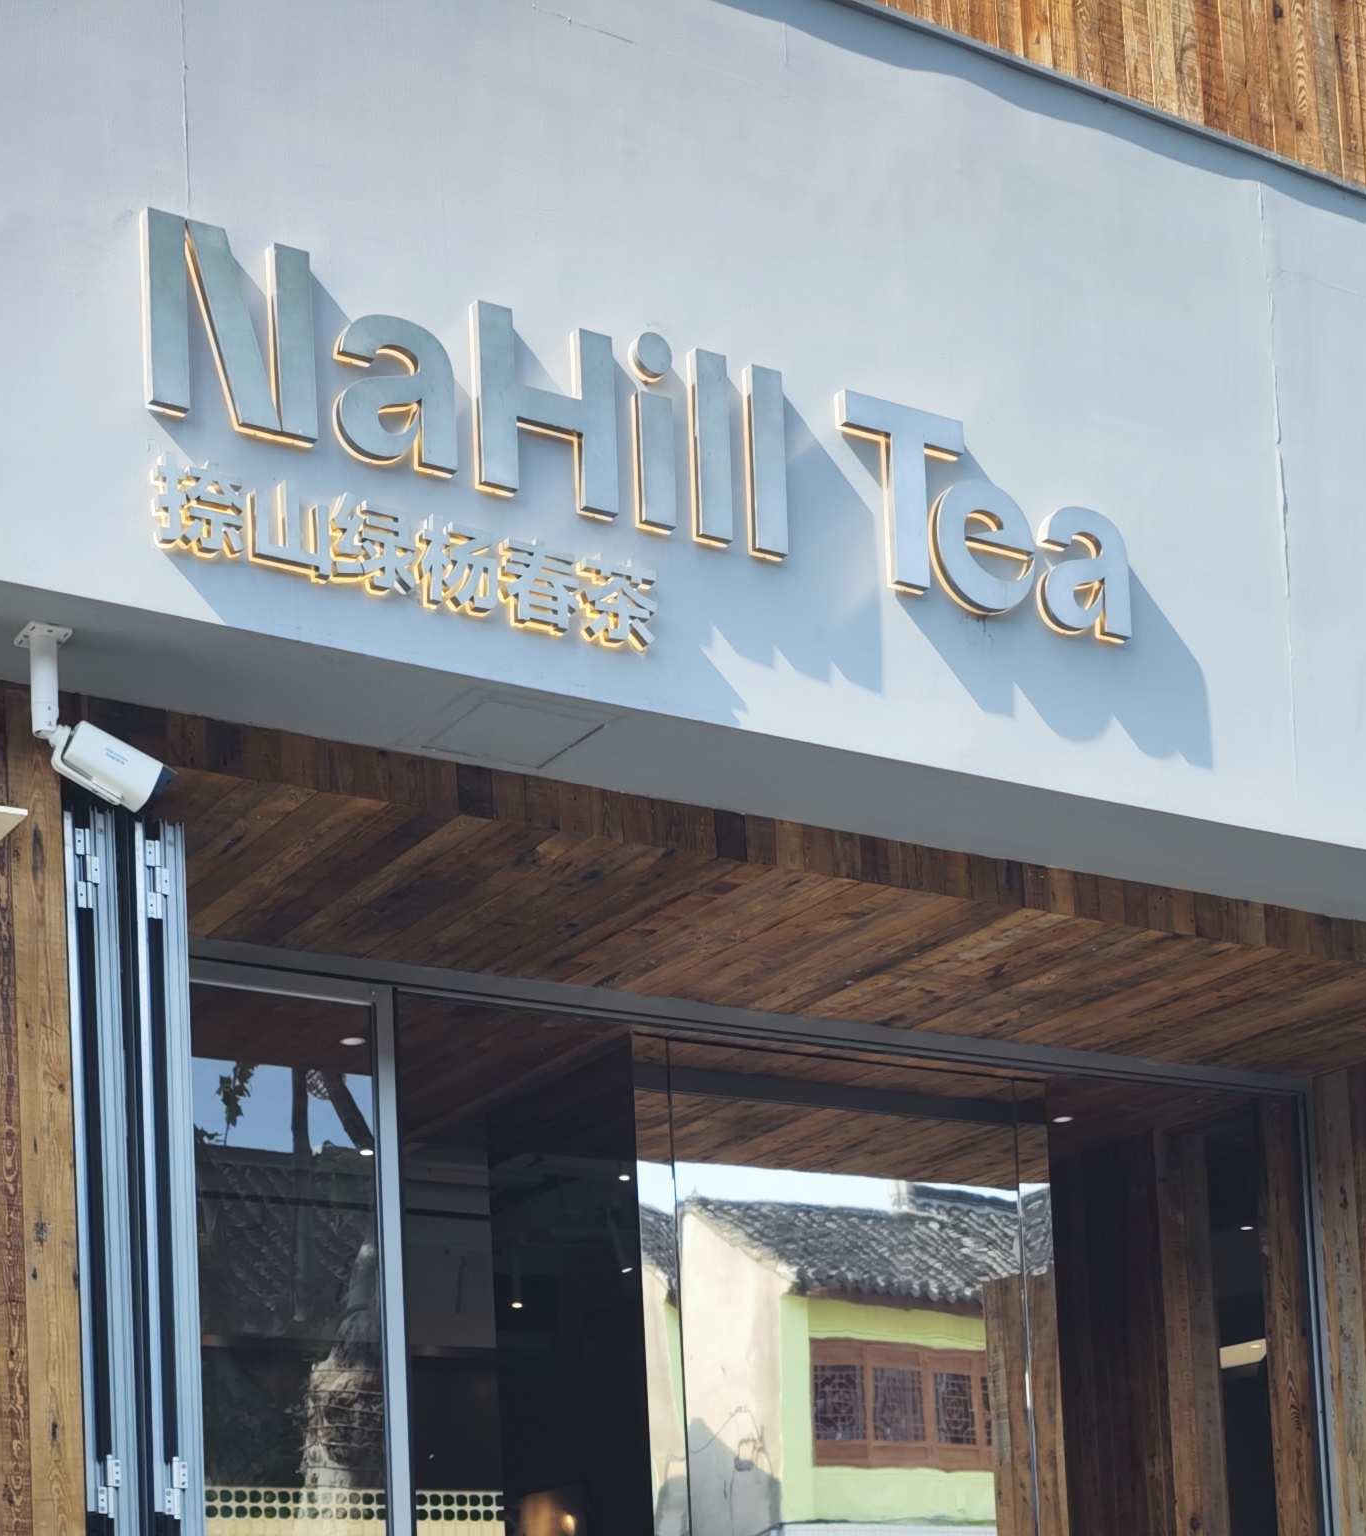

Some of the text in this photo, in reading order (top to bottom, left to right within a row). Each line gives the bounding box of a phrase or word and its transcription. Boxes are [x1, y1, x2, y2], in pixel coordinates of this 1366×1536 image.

[138, 205, 1132, 646] NaHill Tea
[150, 451, 659, 654] 捺山绿杨春茶
